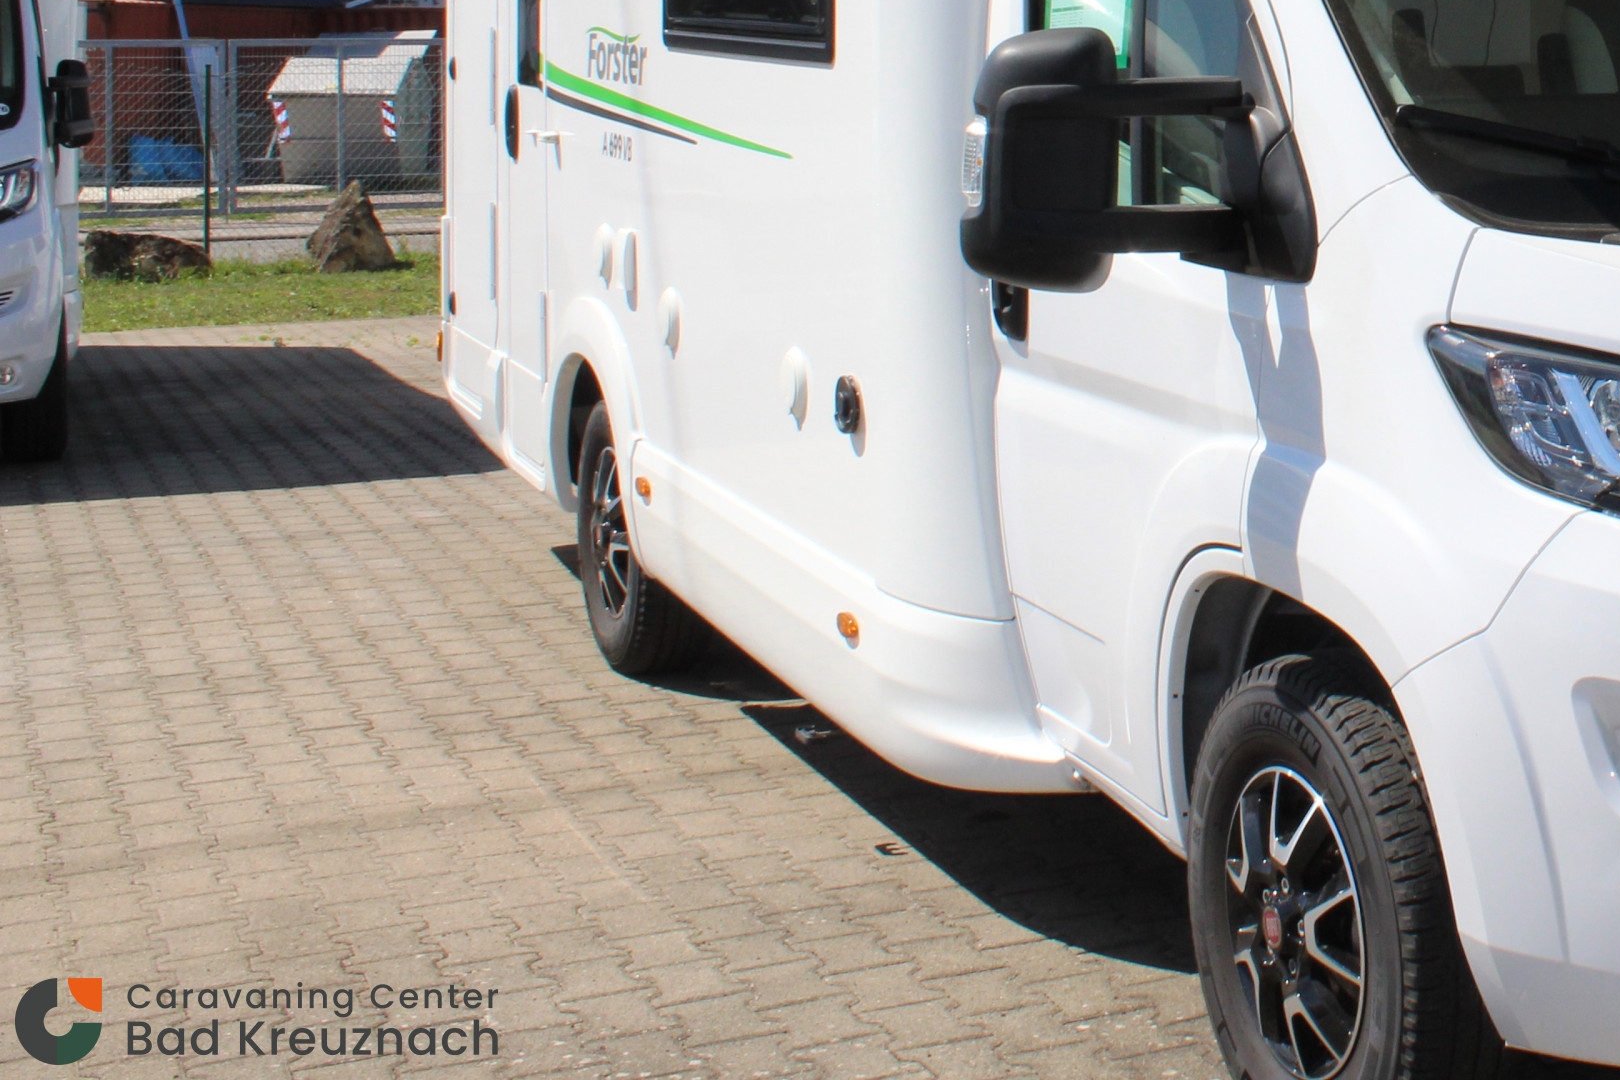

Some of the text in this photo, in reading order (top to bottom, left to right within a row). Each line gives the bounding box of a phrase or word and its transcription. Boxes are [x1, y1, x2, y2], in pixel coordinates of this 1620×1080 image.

[587, 32, 648, 86] Forster
[601, 131, 609, 156] A
[609, 132, 623, 160] 699
[1243, 703, 1322, 759] MICHELIN
